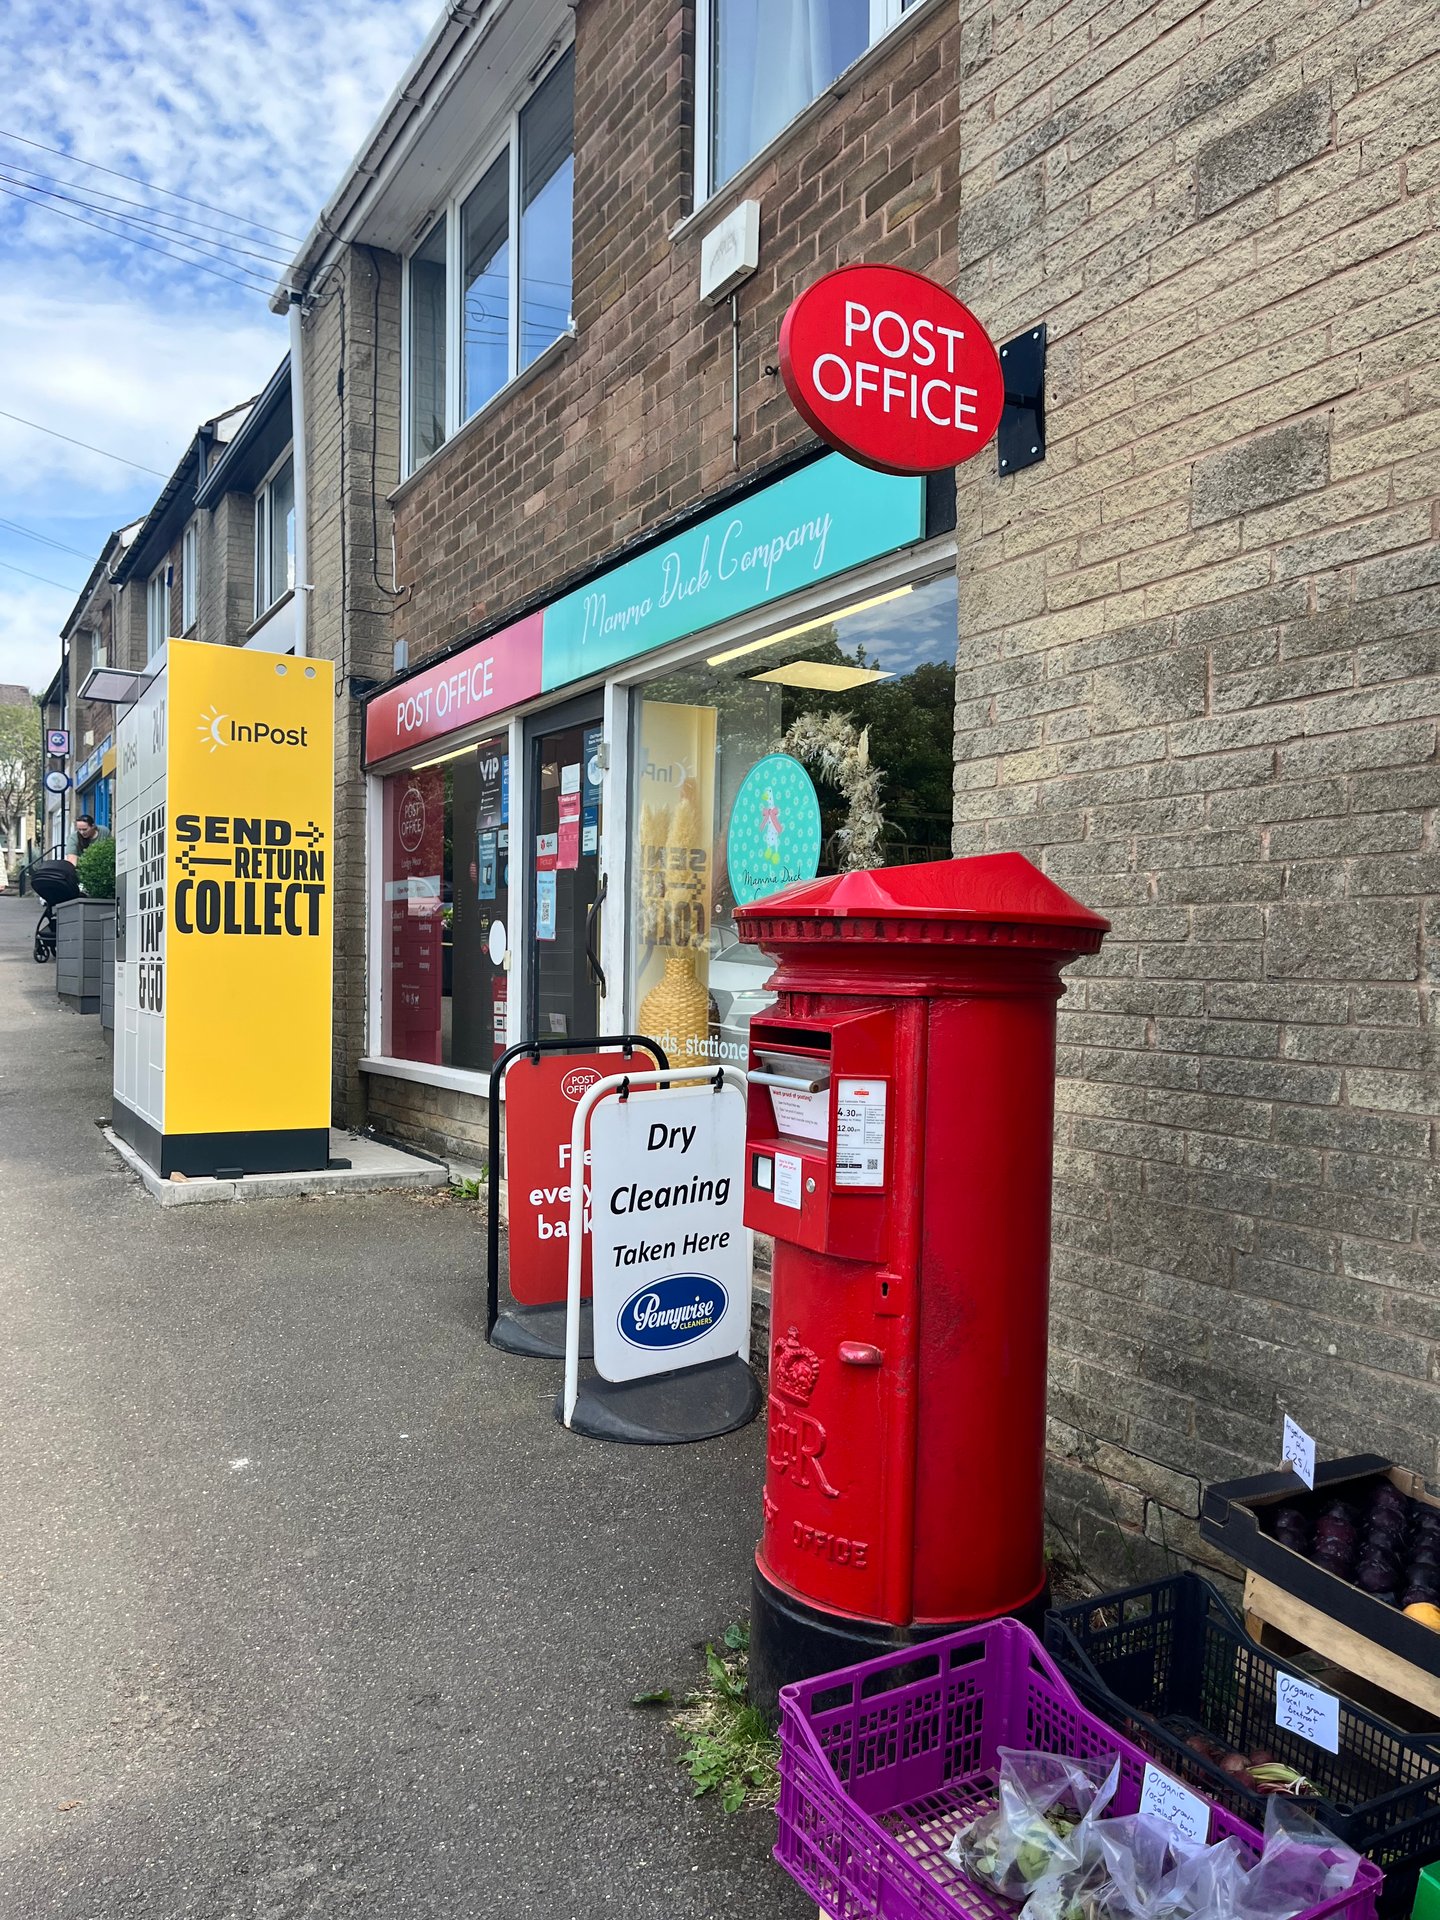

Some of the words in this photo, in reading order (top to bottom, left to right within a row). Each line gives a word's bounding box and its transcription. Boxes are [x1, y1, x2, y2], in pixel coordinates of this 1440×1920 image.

[845, 300, 964, 373] POST
[812, 353, 978, 433] OFFICE
[583, 593, 652, 645] Mamma
[658, 535, 711, 608] Duck
[718, 512, 832, 591] Company
[397, 688, 433, 735] POST
[436, 656, 494, 717] OFFICE
[230, 720, 308, 747] InPost
[480, 757, 499, 781] VIP
[175, 814, 292, 847] SEND
[234, 846, 325, 881] RETURN
[743, 869, 778, 886] Mamma
[780, 864, 801, 883] Duck
[139, 886, 164, 953] TAP
[174, 879, 326, 936] COLLECT
[685, 1034, 748, 1060] statione
[566, 1084, 593, 1094] OFFIC
[571, 1074, 595, 1085] POST
[647, 1123, 697, 1154] Dry
[610, 1175, 731, 1215] Cleaning
[613, 1241, 676, 1267] Taken
[682, 1232, 730, 1255] Here
[633, 1293, 714, 1331] Pennywise
[680, 1317, 713, 1330] CLEANERS
[793, 1519, 868, 1568] OFFICE
[1280, 1678, 1315, 1700] Organic
[1282, 1693, 1301, 1708] local
[1283, 1716, 1315, 1737] 2.25
[1145, 1787, 1166, 1806] local
[1148, 1772, 1186, 1800] Organic
